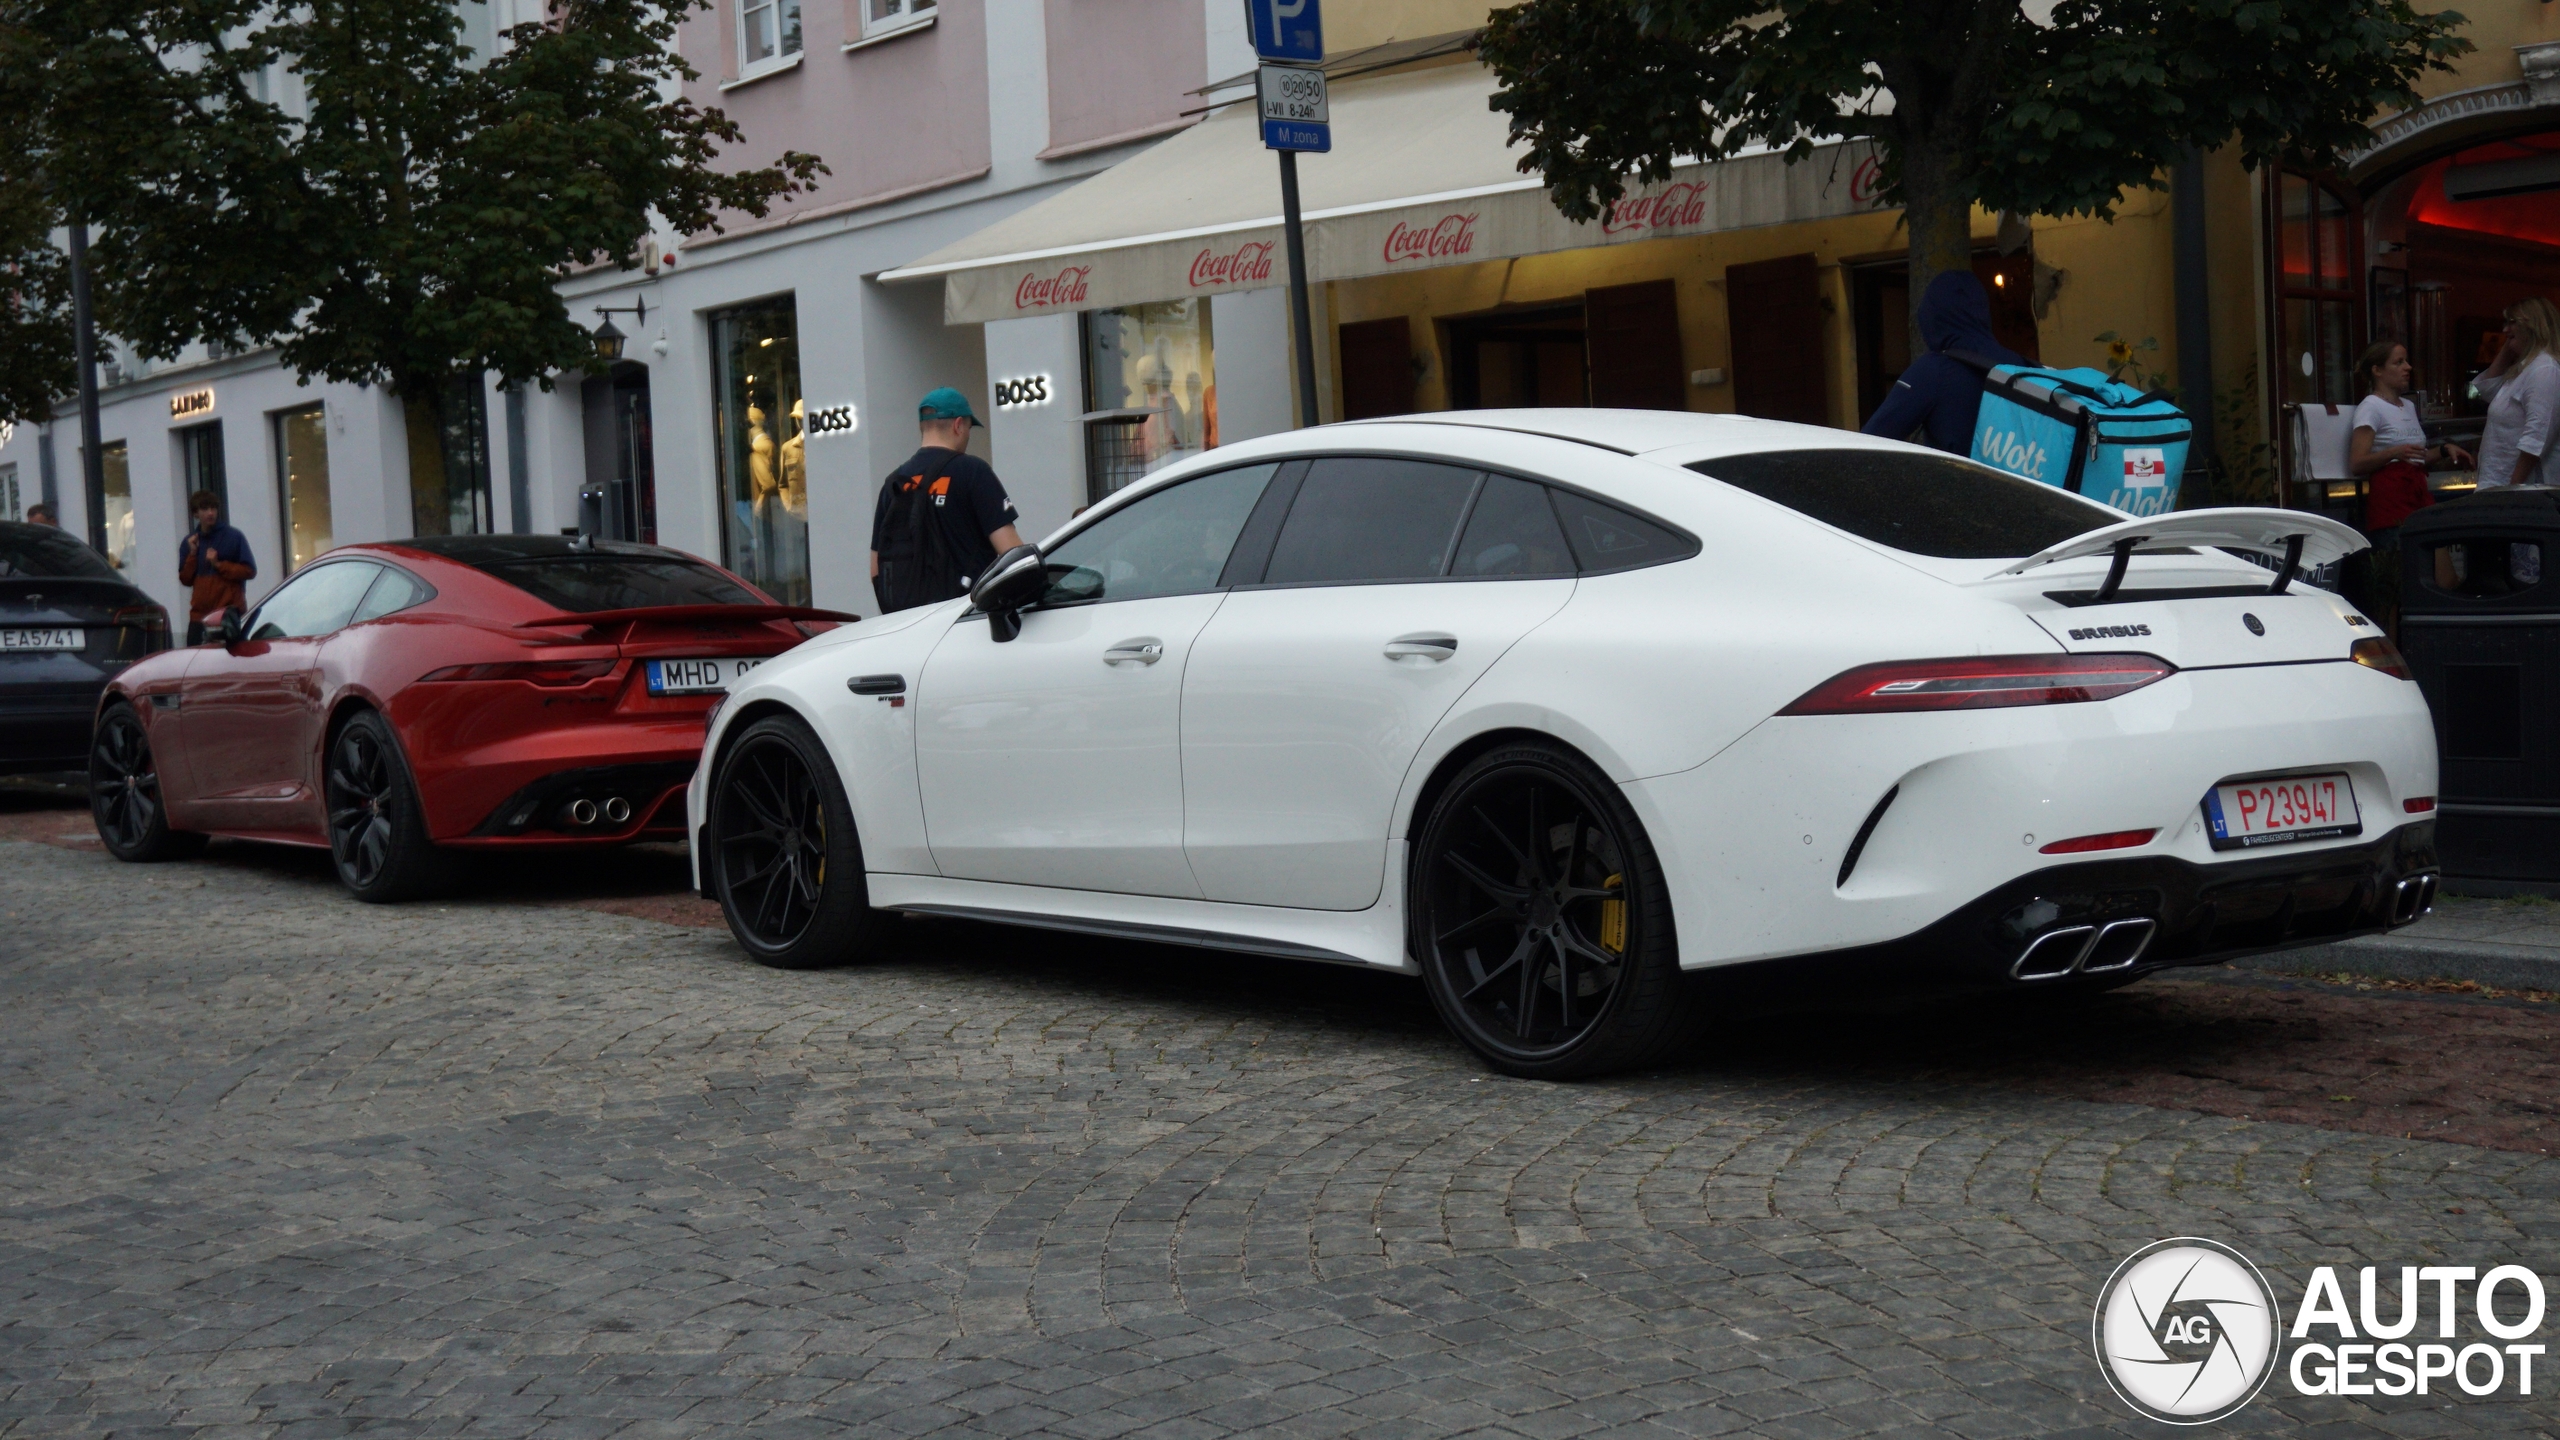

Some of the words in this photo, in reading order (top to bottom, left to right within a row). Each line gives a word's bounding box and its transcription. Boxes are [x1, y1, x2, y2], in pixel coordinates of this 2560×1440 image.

[1270, 0, 1306, 47] P
[1282, 80, 1291, 91] 10
[1293, 80, 1304, 94] 20
[1305, 79, 1321, 97] 50
[1266, 101, 1284, 116] I-VII
[1289, 103, 1316, 119] 8-24h
[1278, 127, 1290, 142] M
[1293, 132, 1319, 145] zona
[995, 375, 1047, 406] BOSS
[808, 406, 853, 433] BOSS
[1982, 425, 2047, 479] Wolt
[2108, 486, 2178, 519] Wolt
[3, 629, 75, 647] EA5741
[2068, 624, 2152, 641] BRABUS
[651, 677, 662, 687] LT
[665, 661, 720, 686] MHD
[2211, 819, 2226, 832] LT
[2236, 781, 2336, 831] P23947
